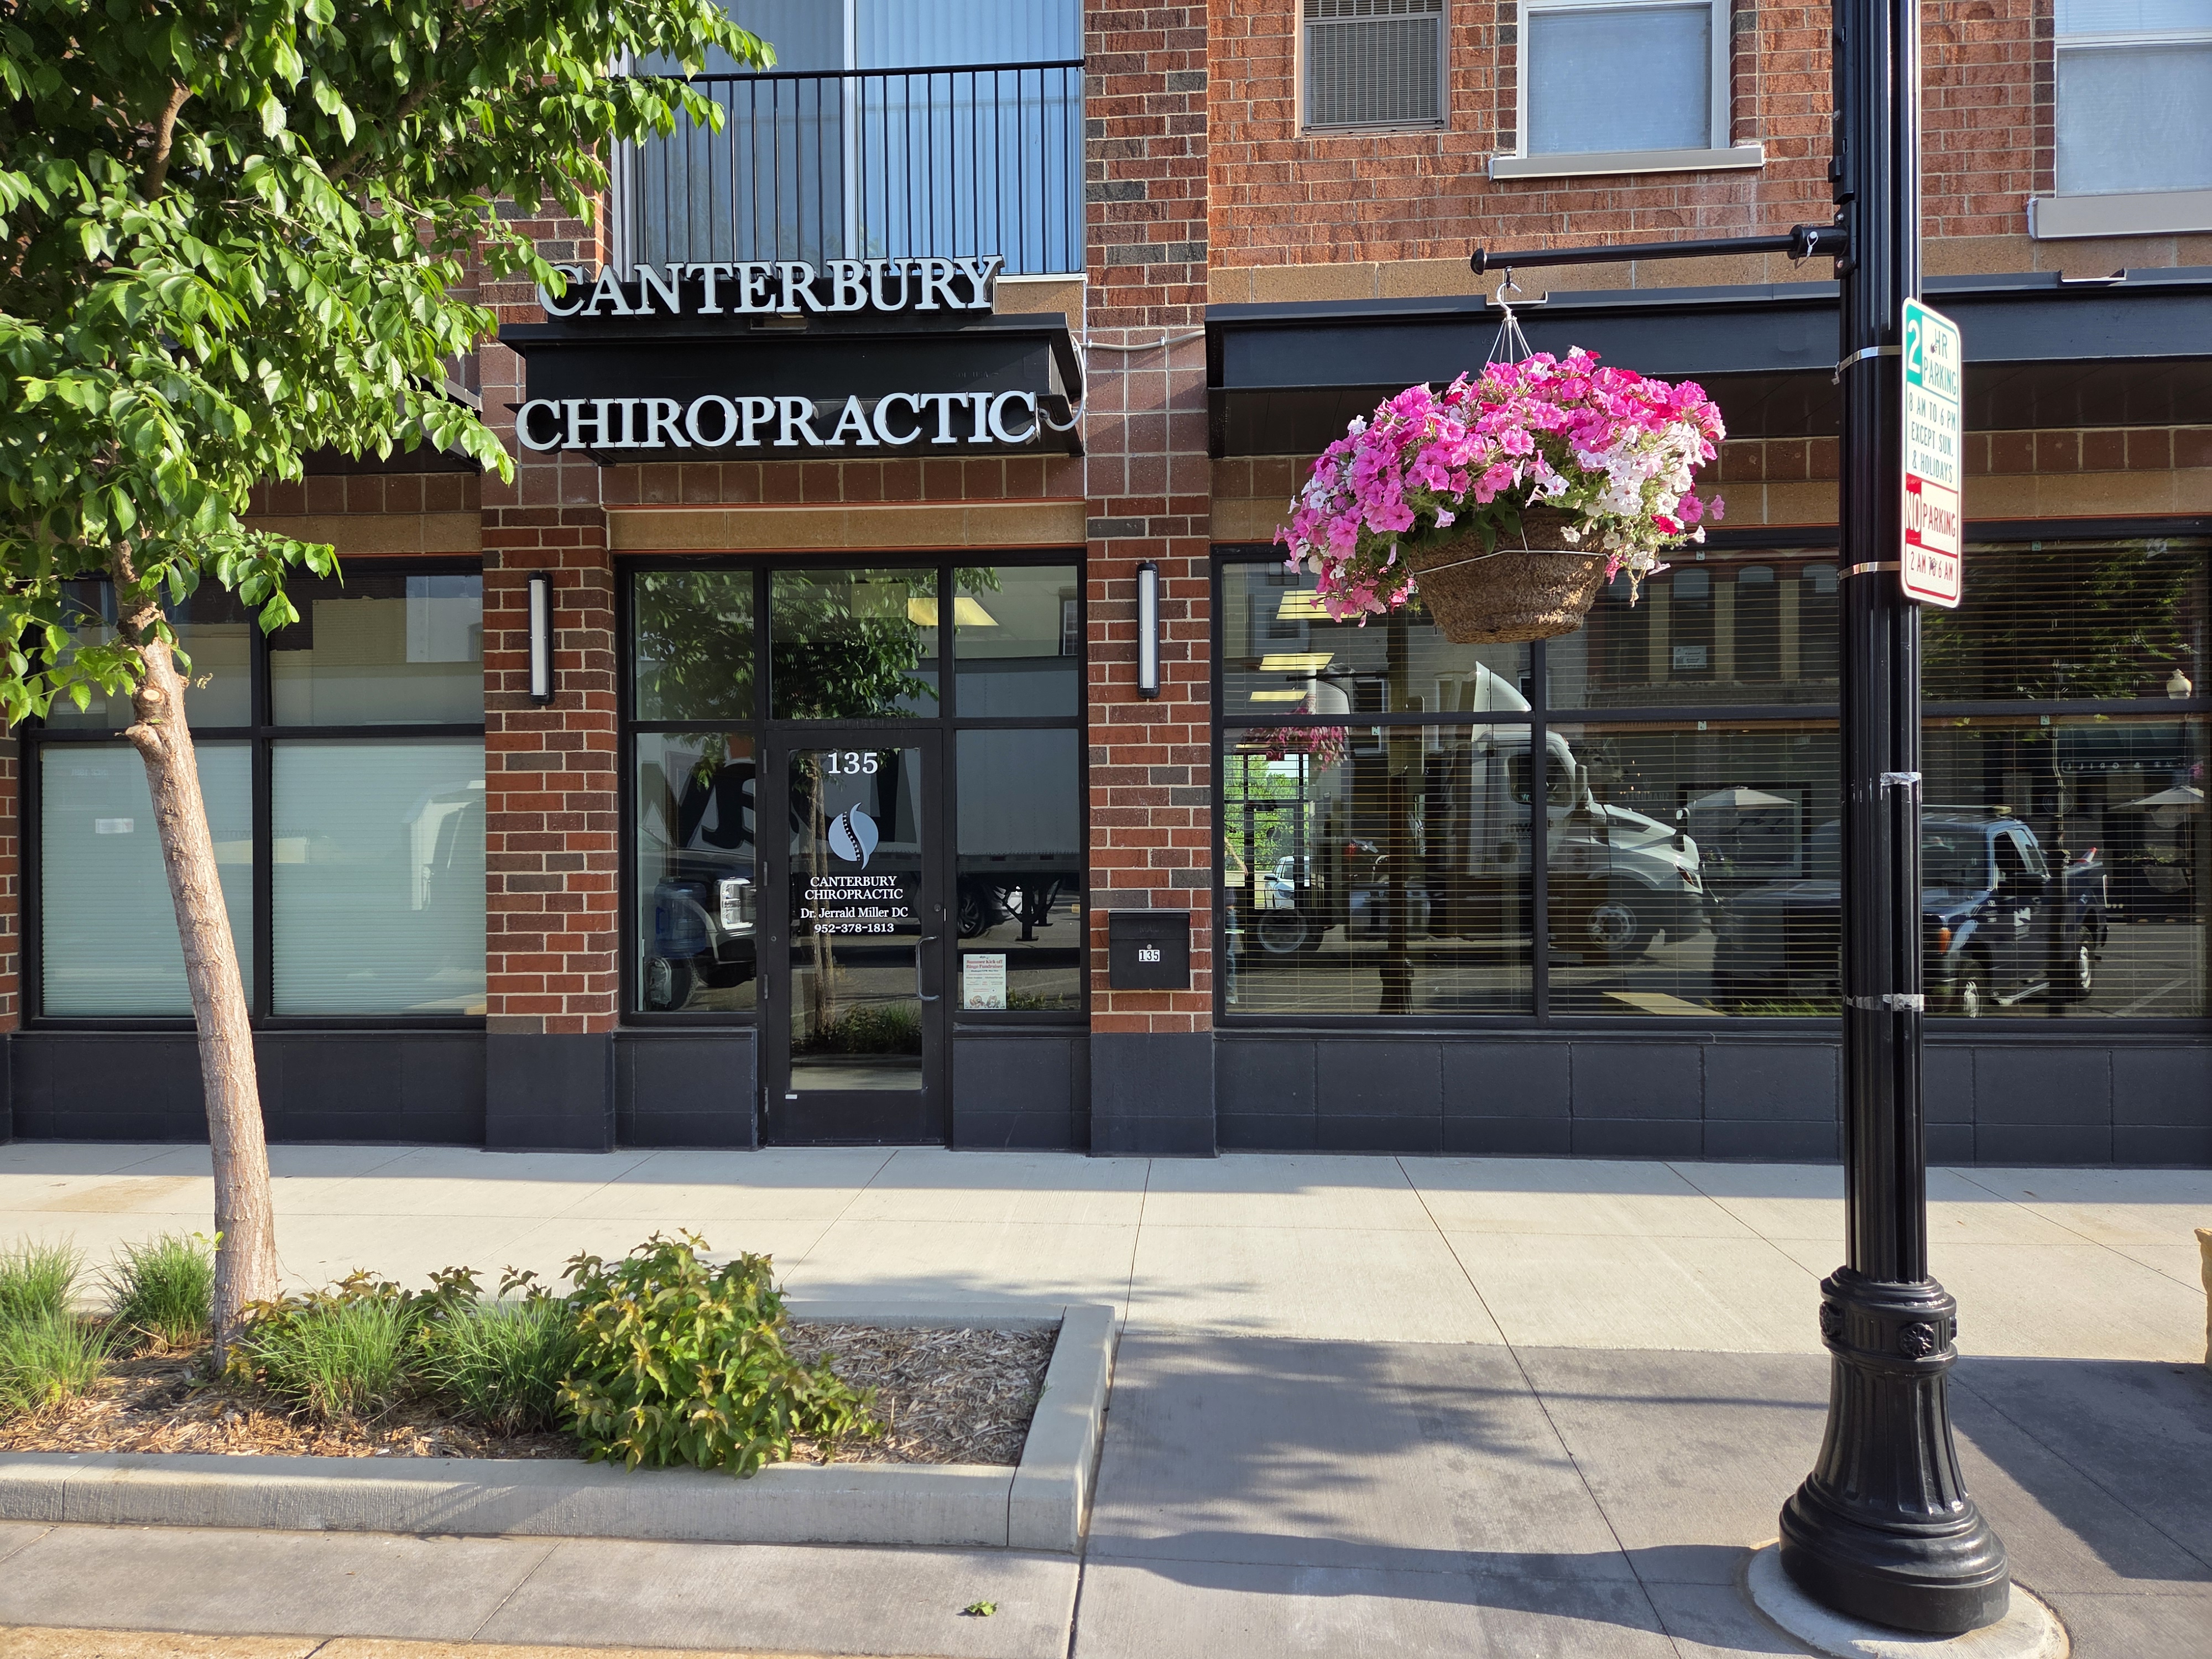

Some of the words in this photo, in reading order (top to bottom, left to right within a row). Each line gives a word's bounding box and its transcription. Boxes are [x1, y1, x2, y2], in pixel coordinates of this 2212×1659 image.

[539, 254, 1004, 317] CANTERBURY
[1907, 319, 1921, 374] 2
[1935, 328, 1948, 359] HR
[1923, 357, 1957, 396] PARKING
[515, 390, 1037, 452] CHIROPRACTIC
[1908, 392, 1913, 412] 8
[1916, 395, 1926, 419] AM
[1929, 401, 1938, 423] TO
[1940, 408, 1944, 426] 6
[1947, 409, 1957, 432] PM
[1911, 421, 1936, 451] EXCEPT
[1912, 450, 1917, 469] &
[1920, 454, 1953, 484] HOLIDAYS
[1906, 489, 1921, 533] NO
[1922, 502, 1956, 538] PARKING
[1910, 551, 1915, 571] 2
[1916, 553, 1926, 575] AM
[1938, 560, 1942, 579] 6
[1944, 561, 1953, 582] AM
[828, 752, 879, 774] 135
[804, 888, 904, 900] CHIROPRACTIC
[810, 875, 898, 888] CANTERBURY
[800, 907, 817, 919] Dr.
[818, 907, 855, 919] Jerrald
[857, 907, 889, 918] Miller
[891, 907, 909, 918] DC
[813, 923, 895, 933] 952-378-1813
[1140, 951, 1159, 961] 135
